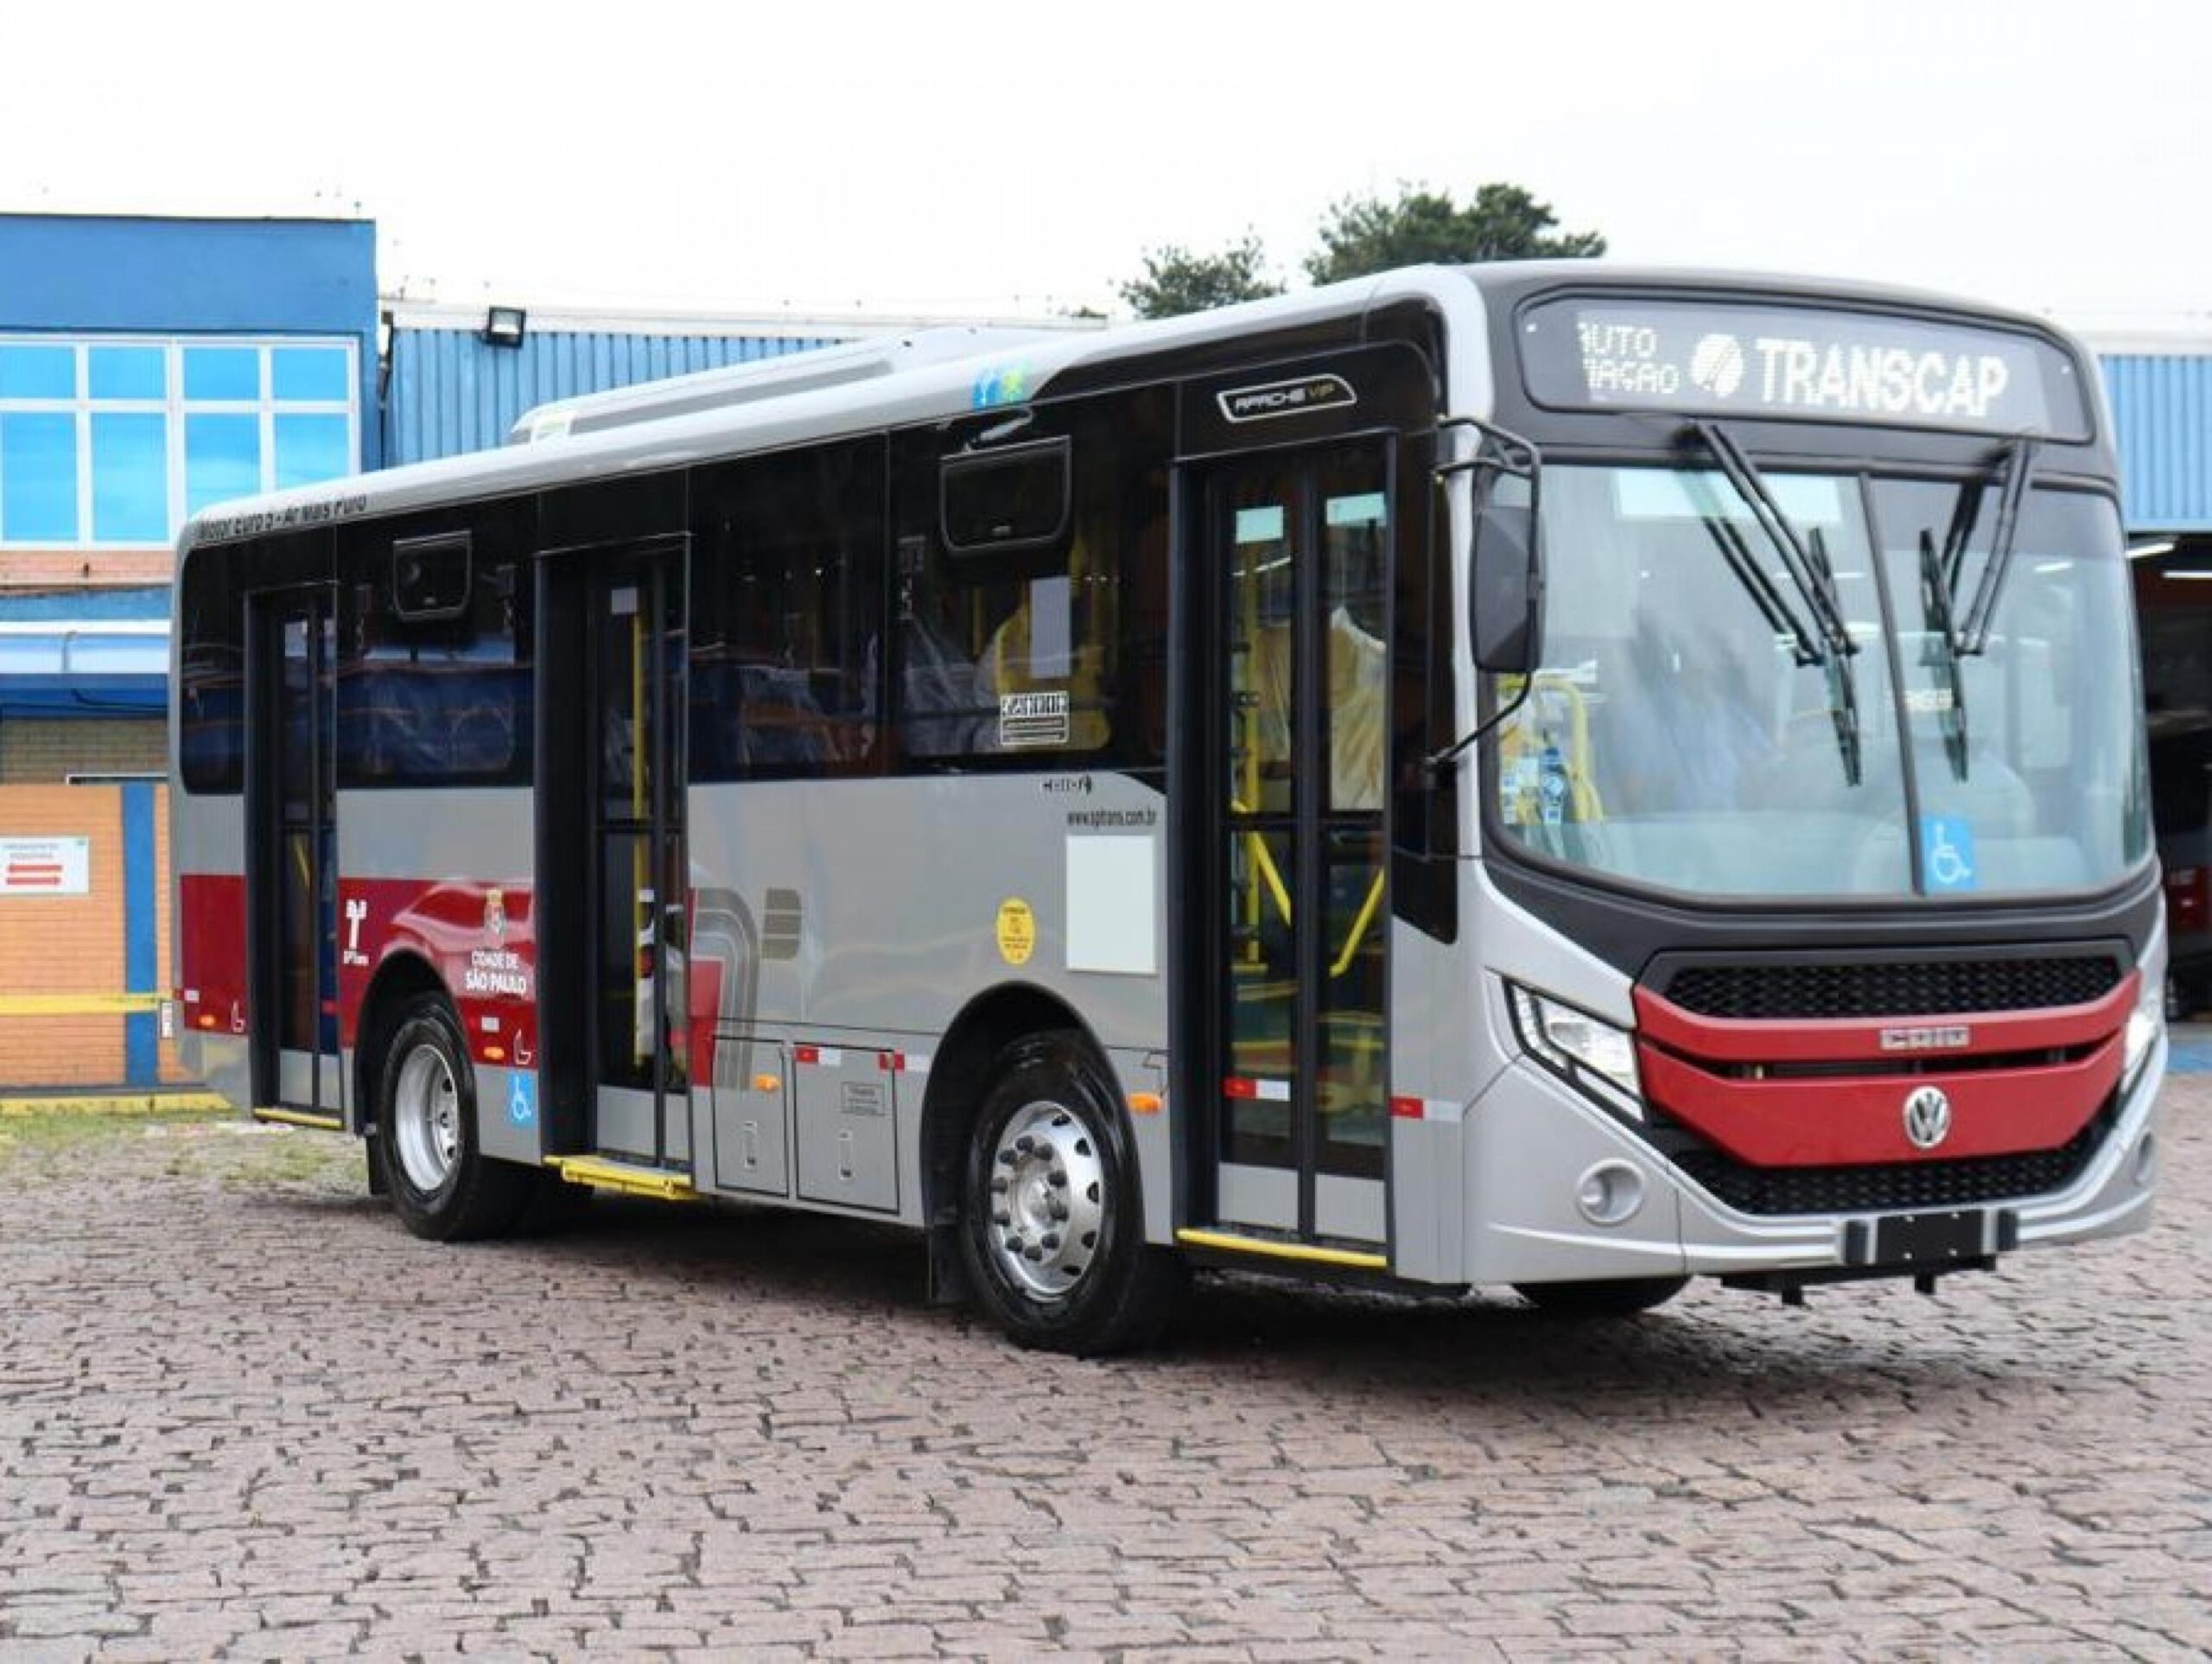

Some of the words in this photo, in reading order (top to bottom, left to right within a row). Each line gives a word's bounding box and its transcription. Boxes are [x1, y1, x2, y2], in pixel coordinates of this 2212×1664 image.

[1757, 337, 2009, 417] TRANSCAP
[465, 969, 487, 991] SÃO
[490, 973, 527, 994] PAULO
